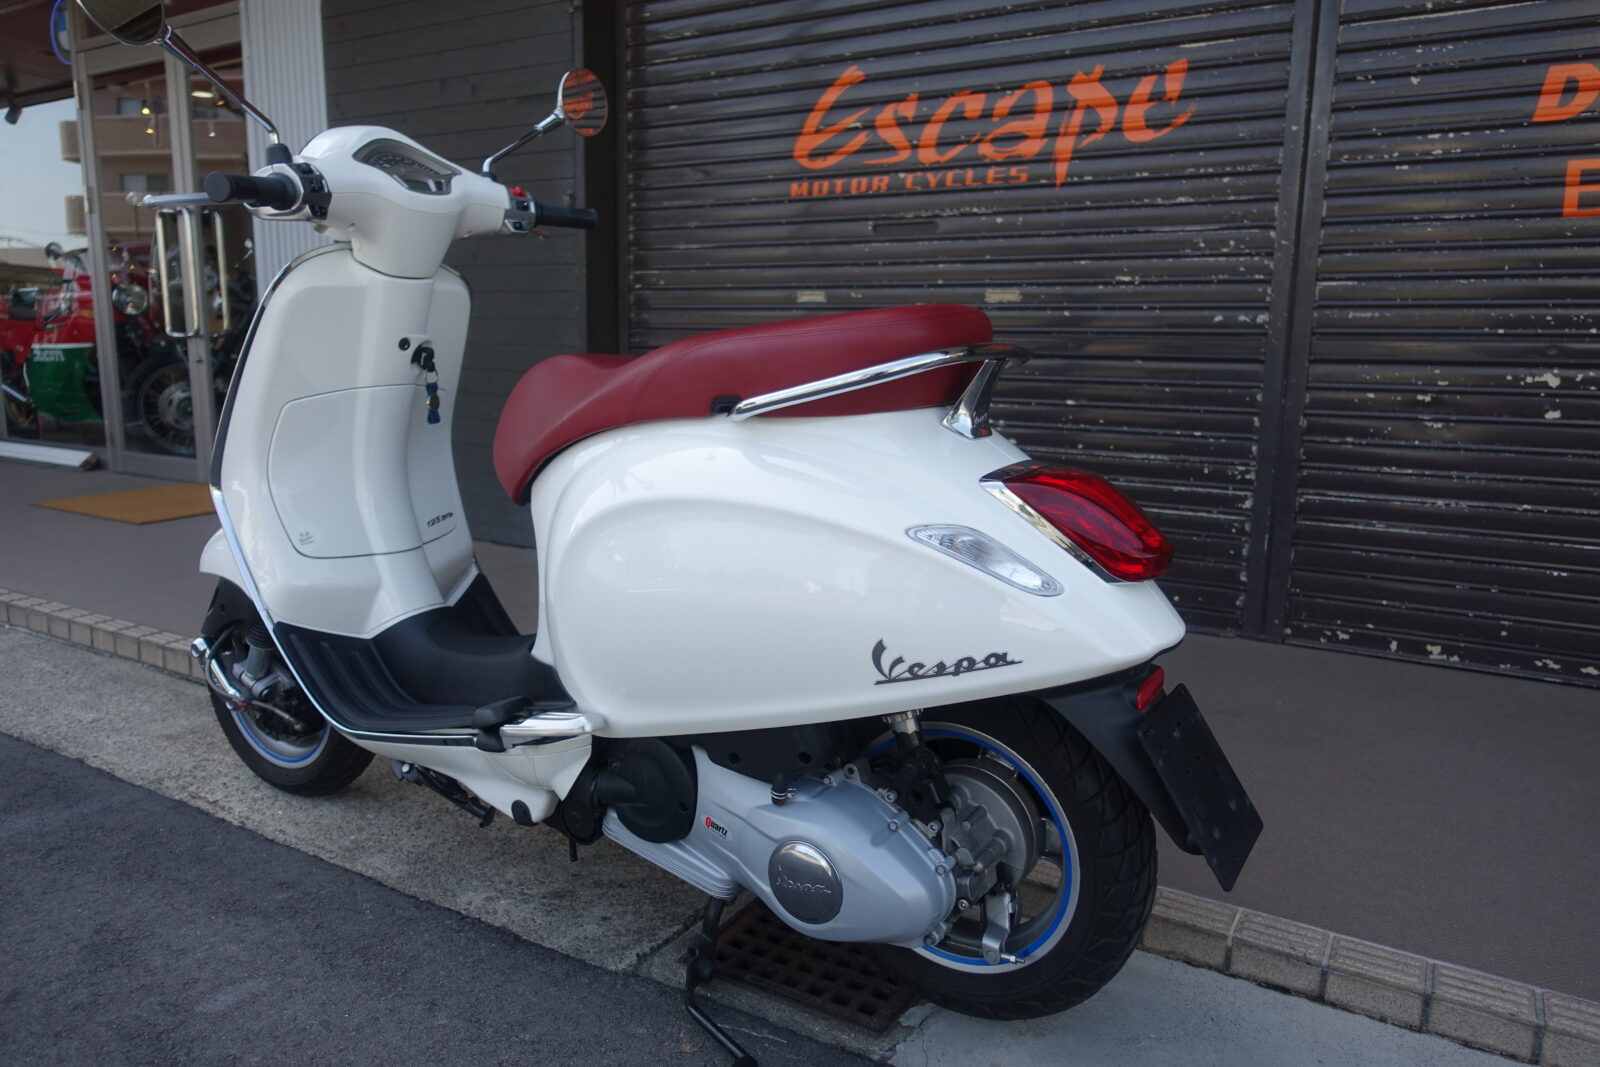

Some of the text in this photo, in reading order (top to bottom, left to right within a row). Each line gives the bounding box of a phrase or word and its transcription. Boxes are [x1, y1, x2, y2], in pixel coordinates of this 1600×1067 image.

[792, 58, 1195, 188] Escape
[789, 166, 1030, 198] MOTOR CYCLES
[872, 639, 1023, 685] Vespa
[705, 816, 729, 838] Quartz
